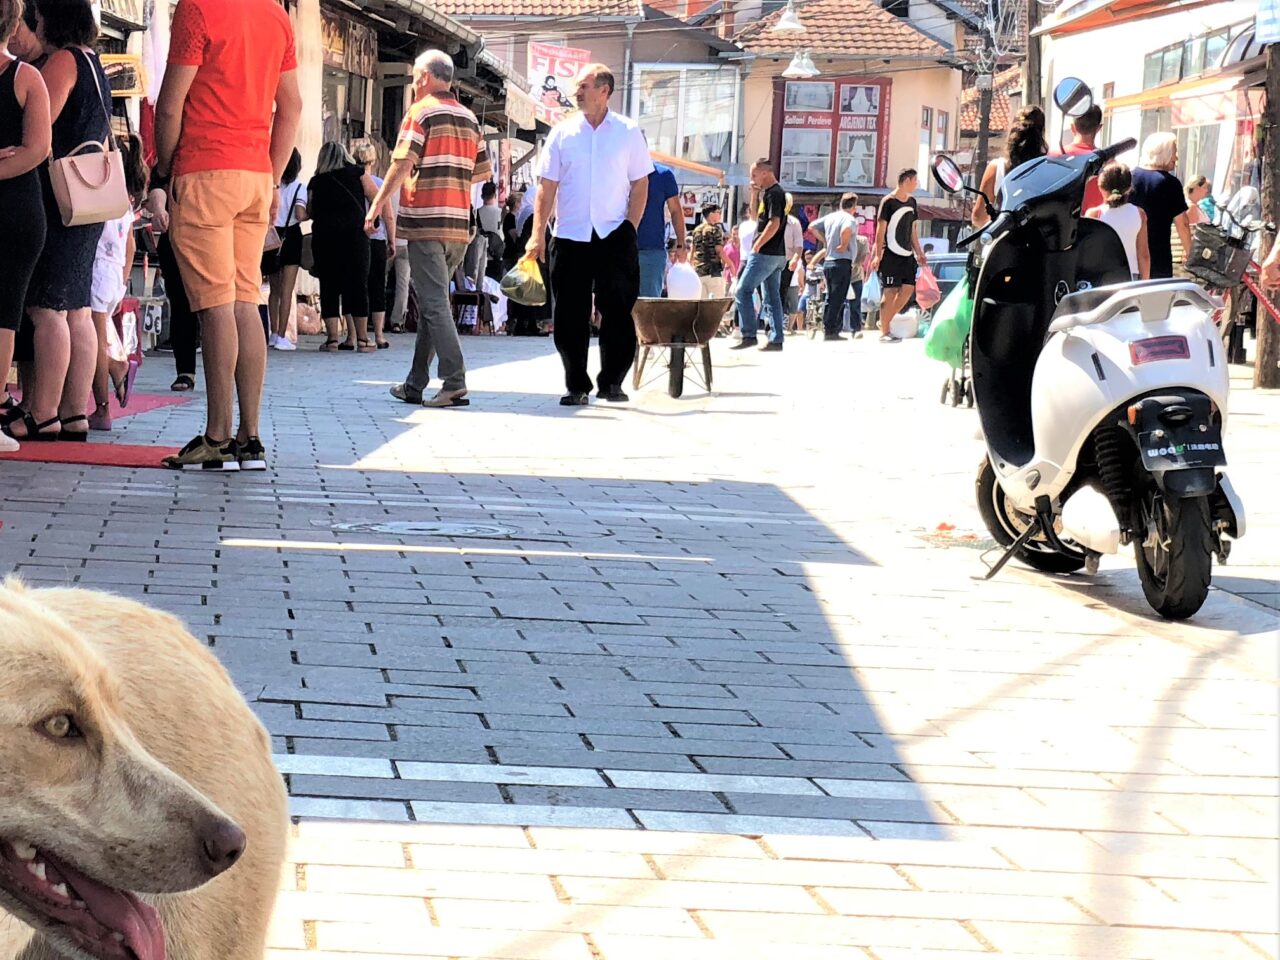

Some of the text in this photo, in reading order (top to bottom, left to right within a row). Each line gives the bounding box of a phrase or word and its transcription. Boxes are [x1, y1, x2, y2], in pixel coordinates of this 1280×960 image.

[531, 55, 587, 78] FIS
[866, 116, 877, 129] TEX
[144, 304, 161, 333] 5€
